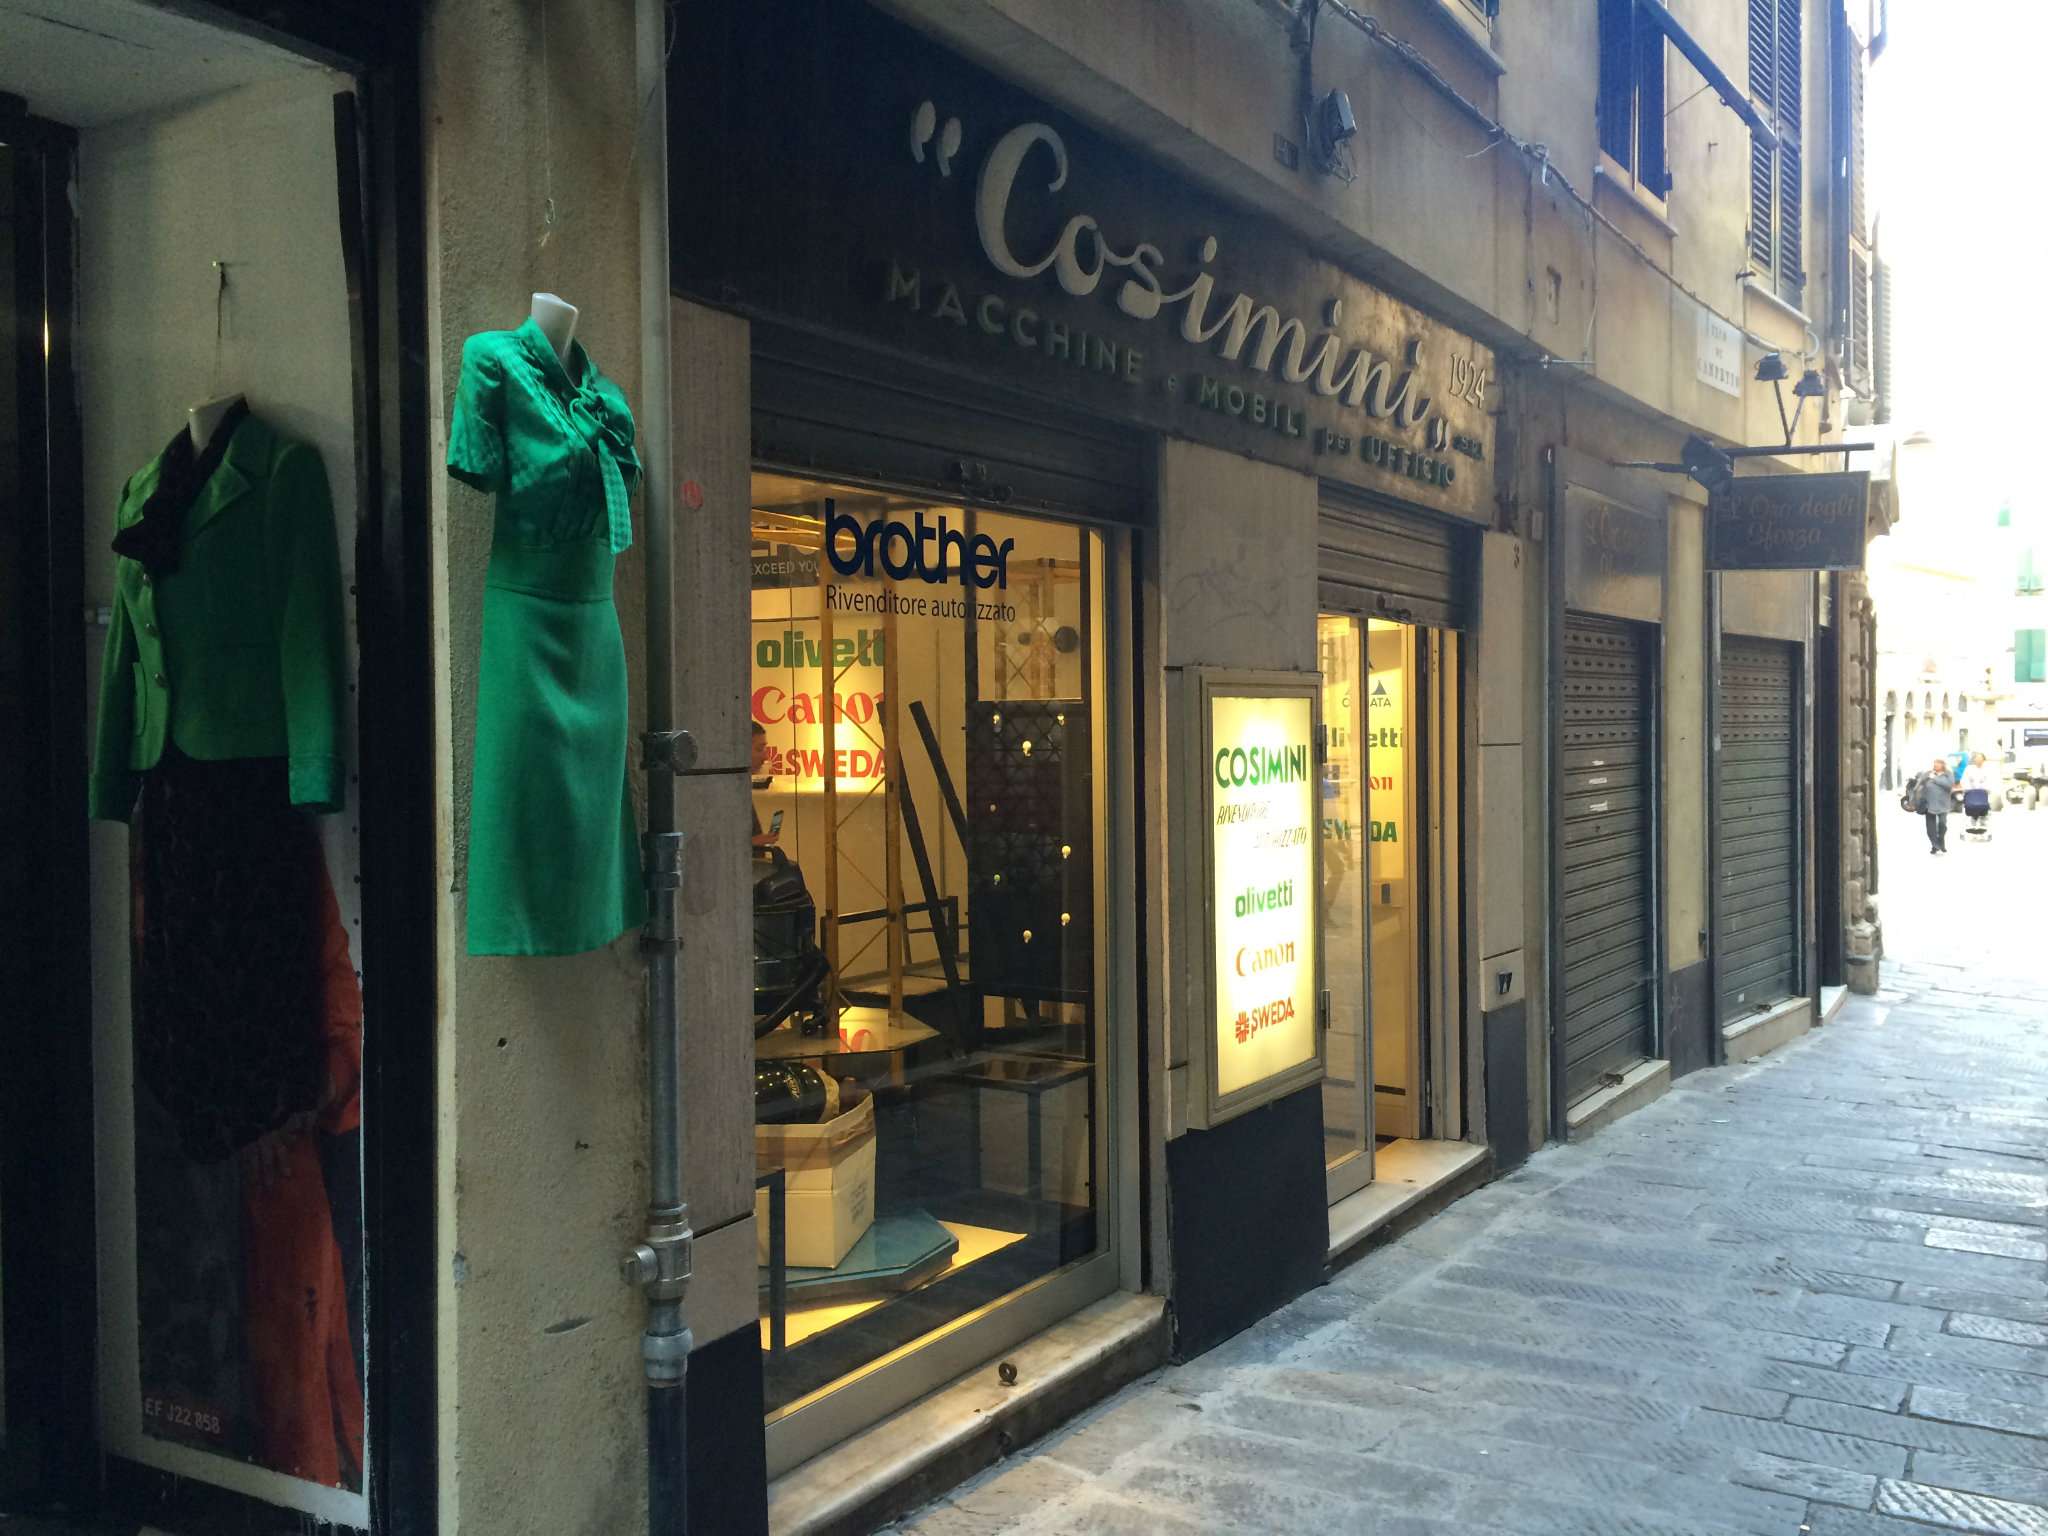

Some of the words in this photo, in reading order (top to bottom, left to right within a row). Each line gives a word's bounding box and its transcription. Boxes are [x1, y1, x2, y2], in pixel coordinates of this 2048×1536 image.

[887, 259, 1145, 385] MACCHINE
[1449, 352, 1487, 409] 1924
[825, 498, 1014, 589] brother
[752, 560, 795, 577] XCEED
[826, 584, 928, 617] Rivenditore
[931, 598, 1016, 623] autozzato
[756, 629, 885, 668] olivett
[752, 686, 884, 725] Cano
[1326, 726, 1404, 748] lietti
[1215, 745, 1307, 789] COSIMINI
[1322, 817, 1398, 843] SWDA
[1235, 879, 1293, 918] olivetti
[1235, 941, 1295, 977] Canon
[1251, 996, 1295, 1039] SWEDA
